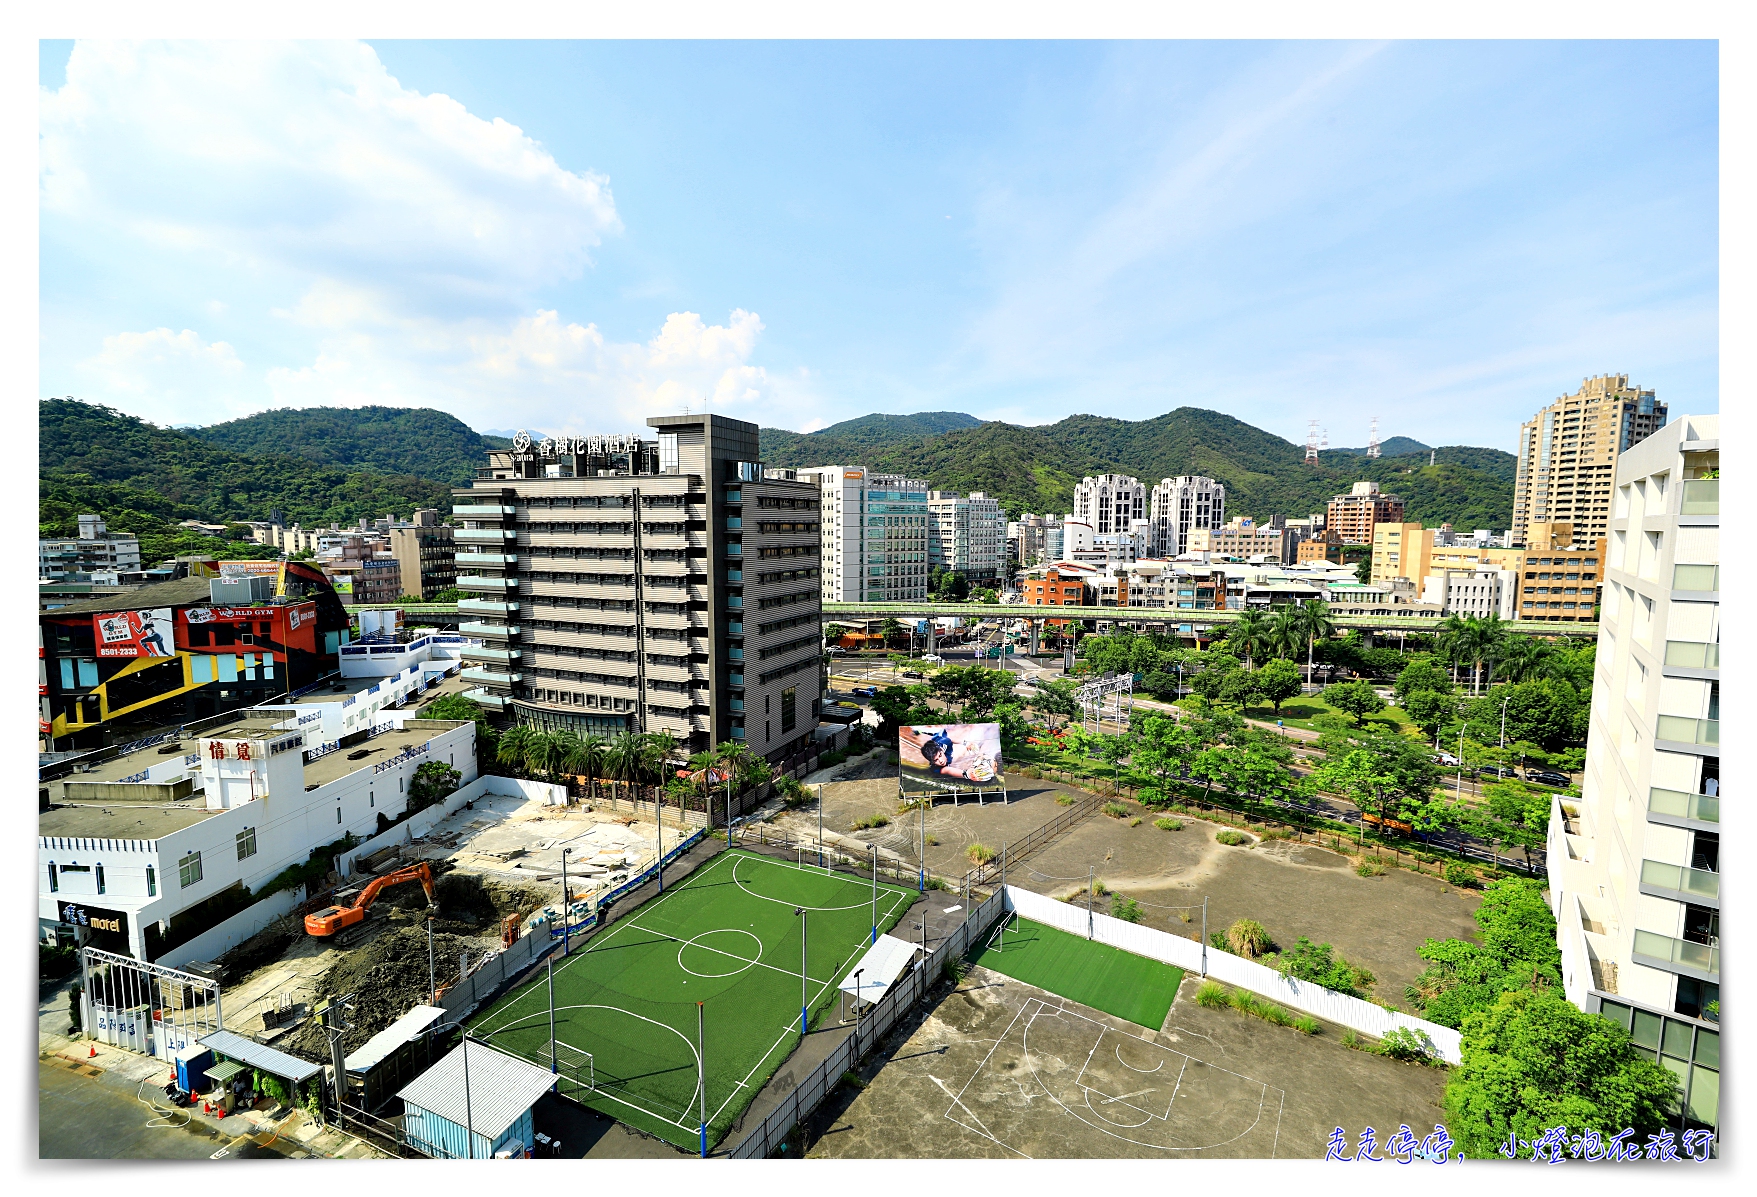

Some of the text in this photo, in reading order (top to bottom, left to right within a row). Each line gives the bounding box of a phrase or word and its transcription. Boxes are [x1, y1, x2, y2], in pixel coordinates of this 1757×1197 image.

[539, 433, 640, 456] 香樹花園酒店
[100, 648, 138, 656] 8501-2333
[90, 917, 120, 932] motel
